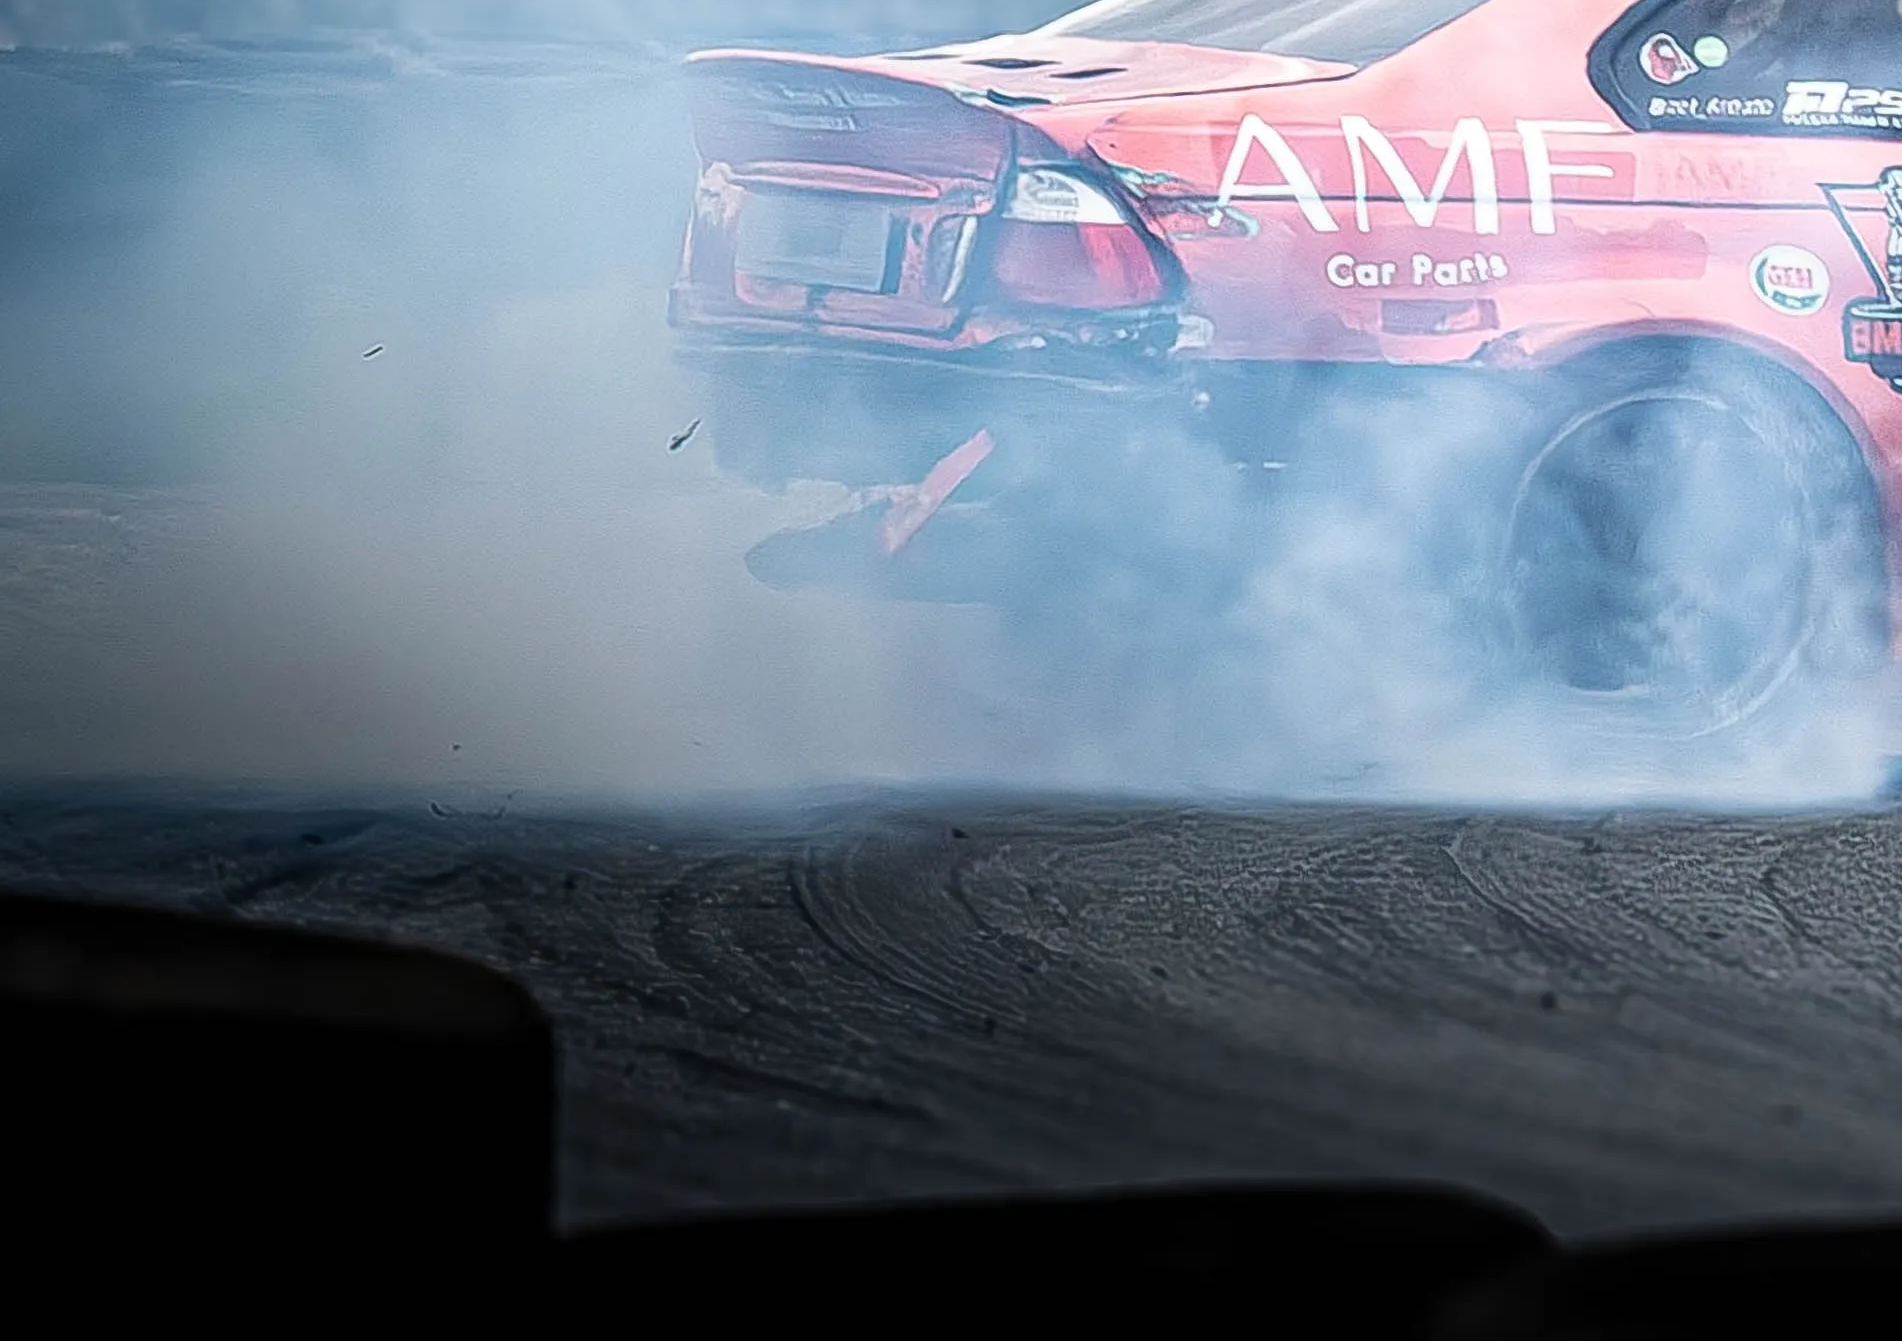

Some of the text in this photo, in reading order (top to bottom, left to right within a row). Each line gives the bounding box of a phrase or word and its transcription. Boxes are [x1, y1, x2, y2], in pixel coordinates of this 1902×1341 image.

[1208, 114, 1617, 235] AMF
[1327, 252, 1508, 290] Car Parts
[1851, 320, 1902, 356] BM
